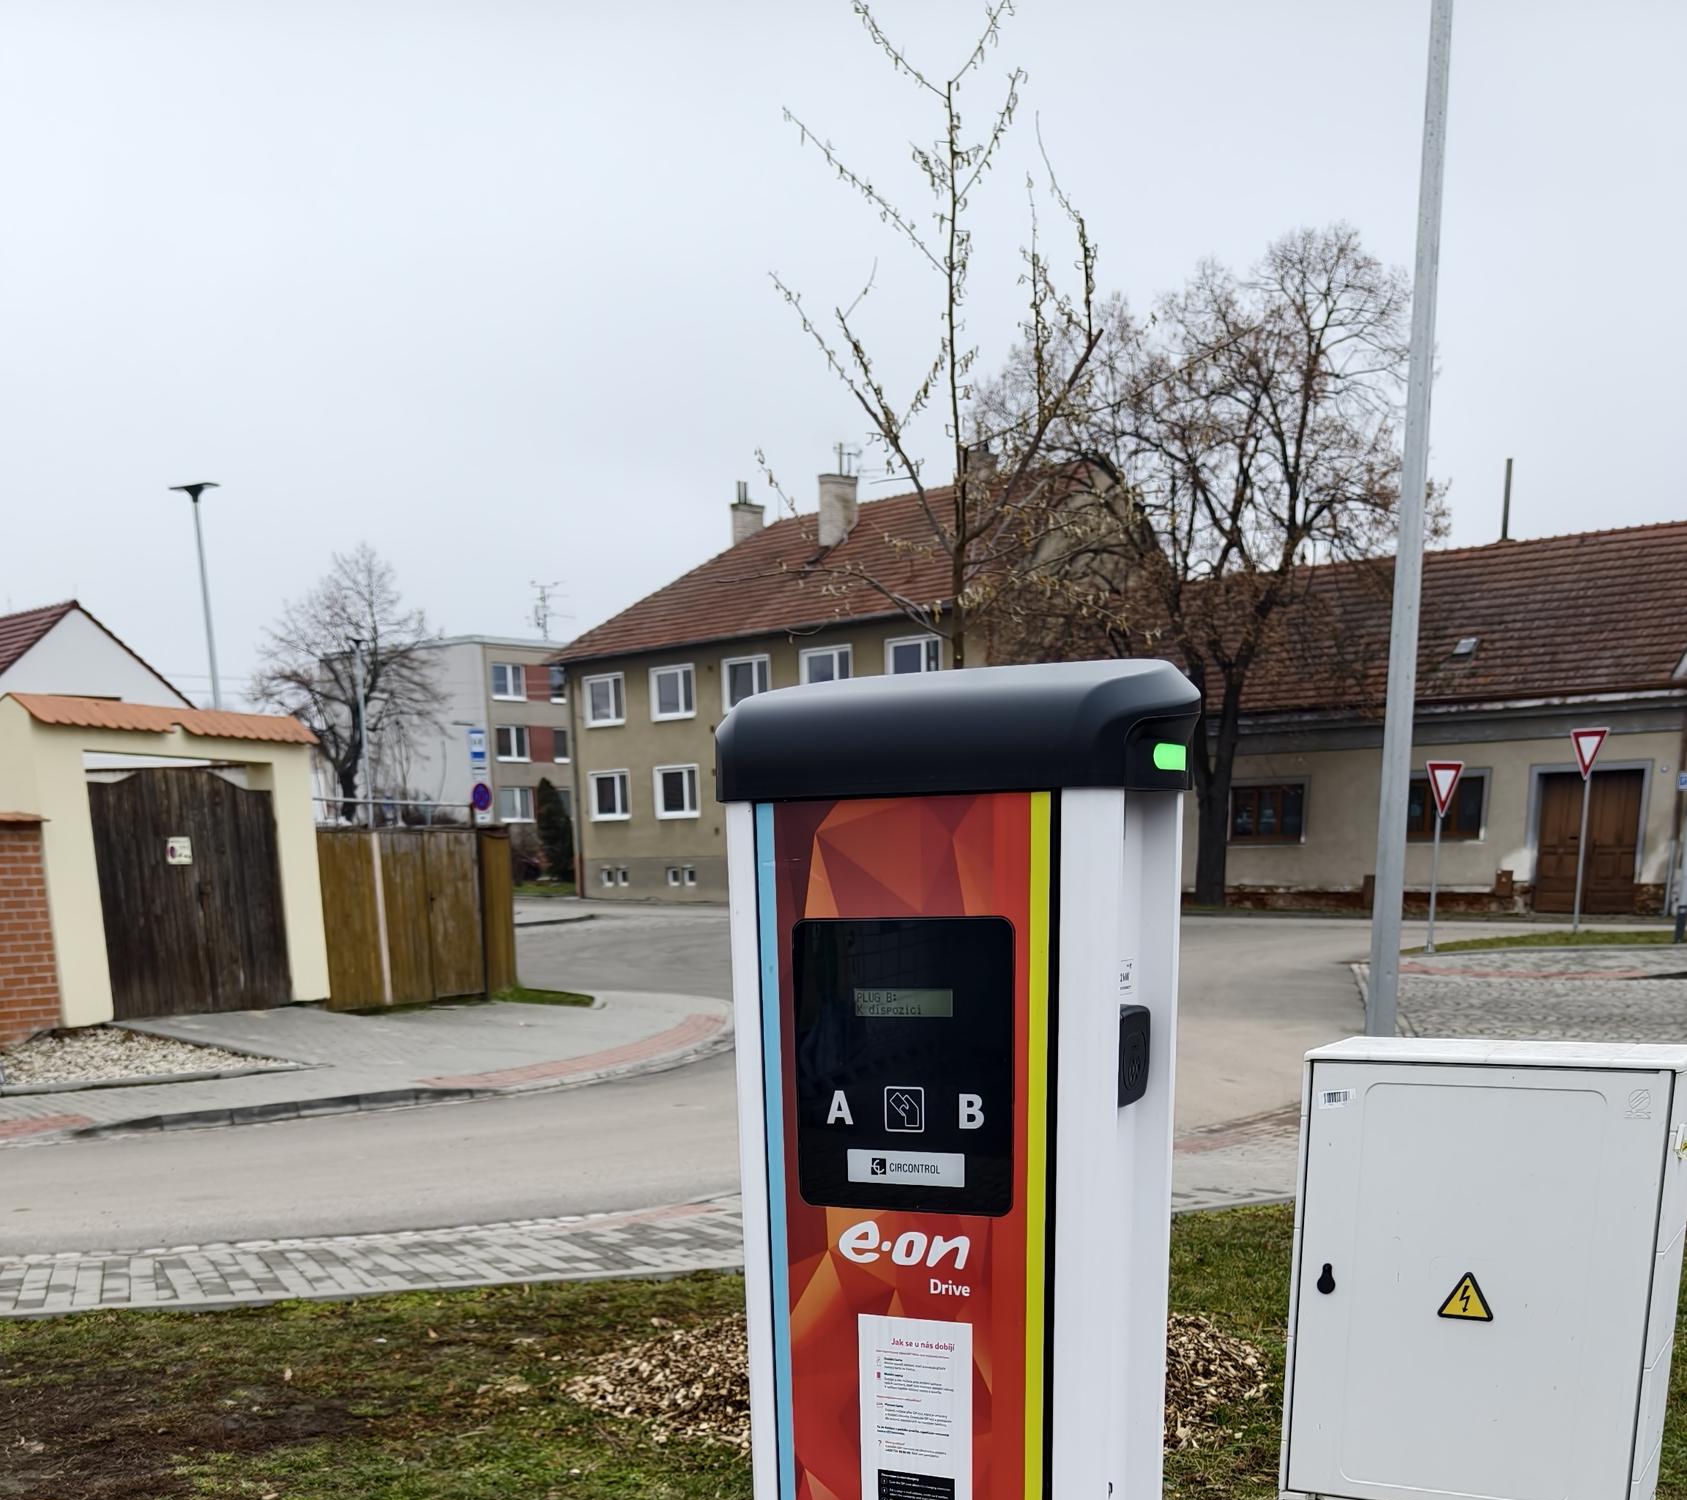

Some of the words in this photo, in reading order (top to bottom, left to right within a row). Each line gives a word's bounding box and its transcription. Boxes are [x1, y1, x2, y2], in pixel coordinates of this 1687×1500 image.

[856, 992, 881, 1003] PLUG
[886, 992, 897, 1003] B:
[856, 1004, 864, 1015] K
[826, 1090, 854, 1125] A
[958, 1093, 985, 1130] B
[889, 1162, 941, 1175] CIRCONTROL
[929, 1278, 971, 1297] Drive
[891, 1338, 904, 1346] Jak
[920, 1341, 934, 1350] nás
